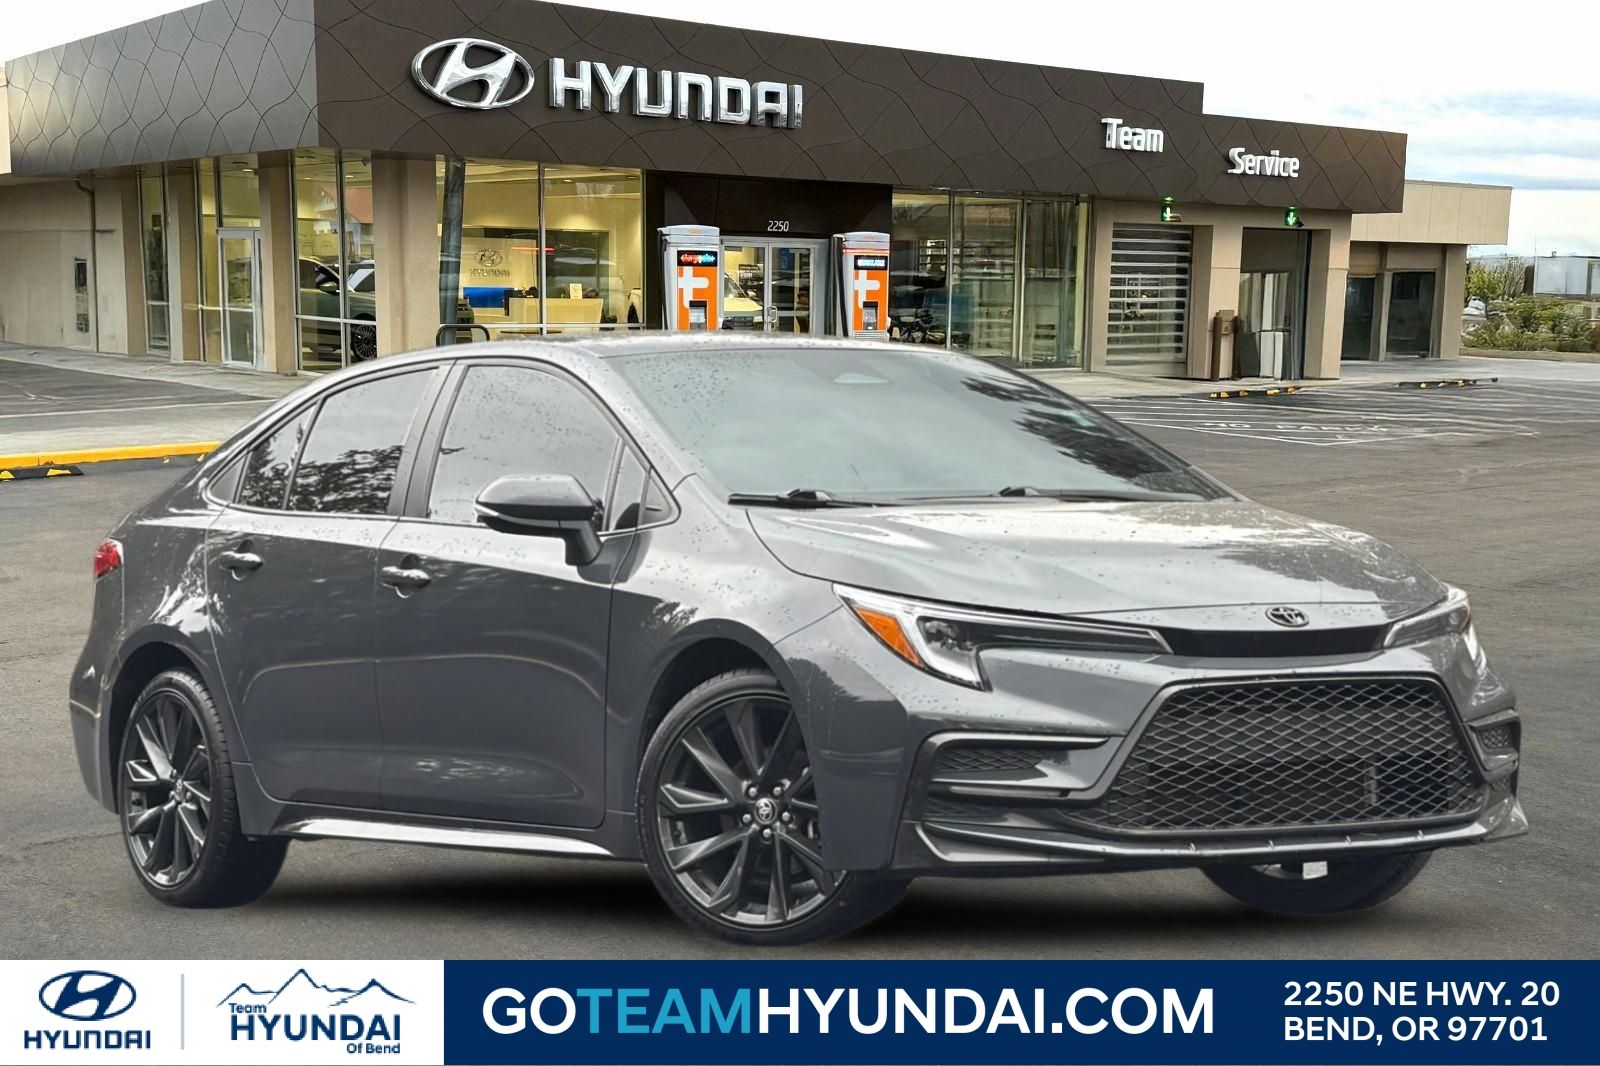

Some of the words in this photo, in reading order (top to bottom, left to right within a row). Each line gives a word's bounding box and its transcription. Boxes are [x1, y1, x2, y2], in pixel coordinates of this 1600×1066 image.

[549, 57, 803, 129] HYUNDAI
[1101, 117, 1165, 153] Team
[1227, 147, 1300, 178] Service
[767, 220, 790, 232] 2250
